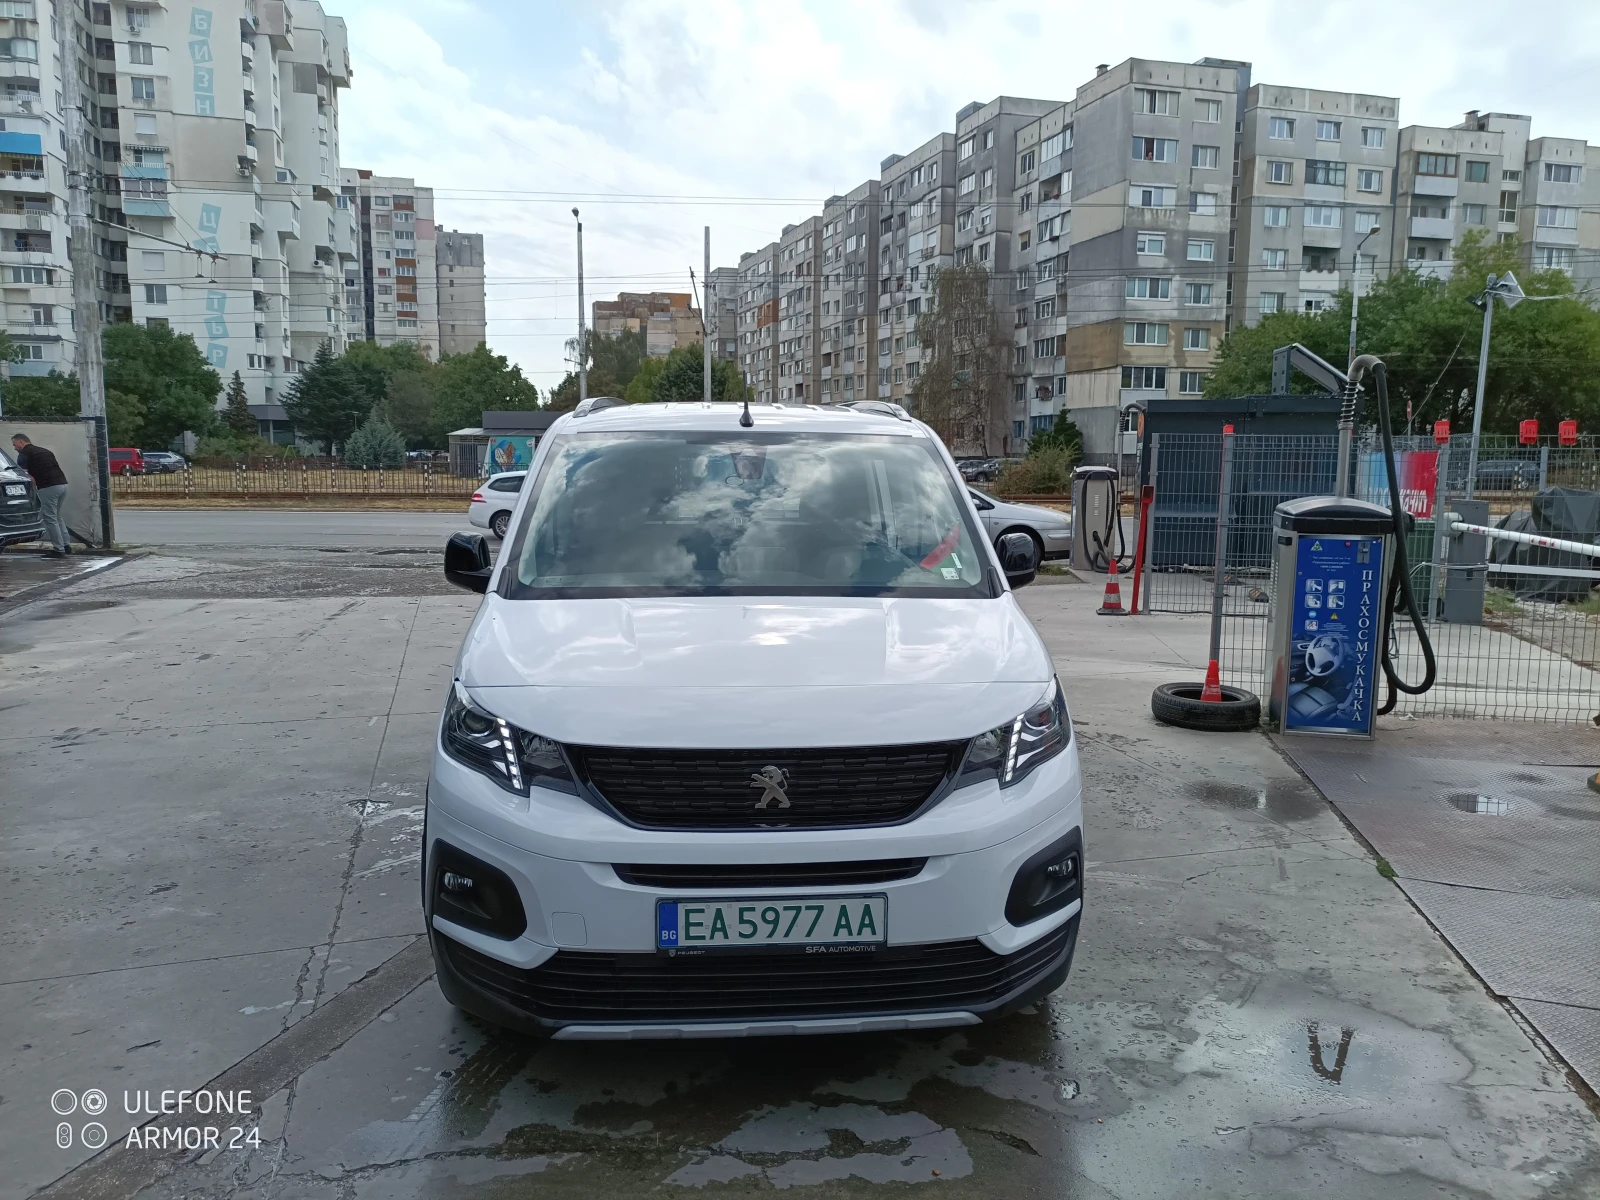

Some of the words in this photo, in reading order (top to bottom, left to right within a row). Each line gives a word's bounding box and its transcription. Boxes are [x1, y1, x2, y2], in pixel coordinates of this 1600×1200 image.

[1352, 569, 1373, 722] ПРАХОСМУКАЧКА
[684, 907, 729, 941] EA
[738, 905, 825, 939] 5977
[833, 903, 877, 937] AA
[661, 930, 677, 940] BG
[805, 946, 827, 954] SFA
[828, 945, 876, 953] AUTOMOTIVE
